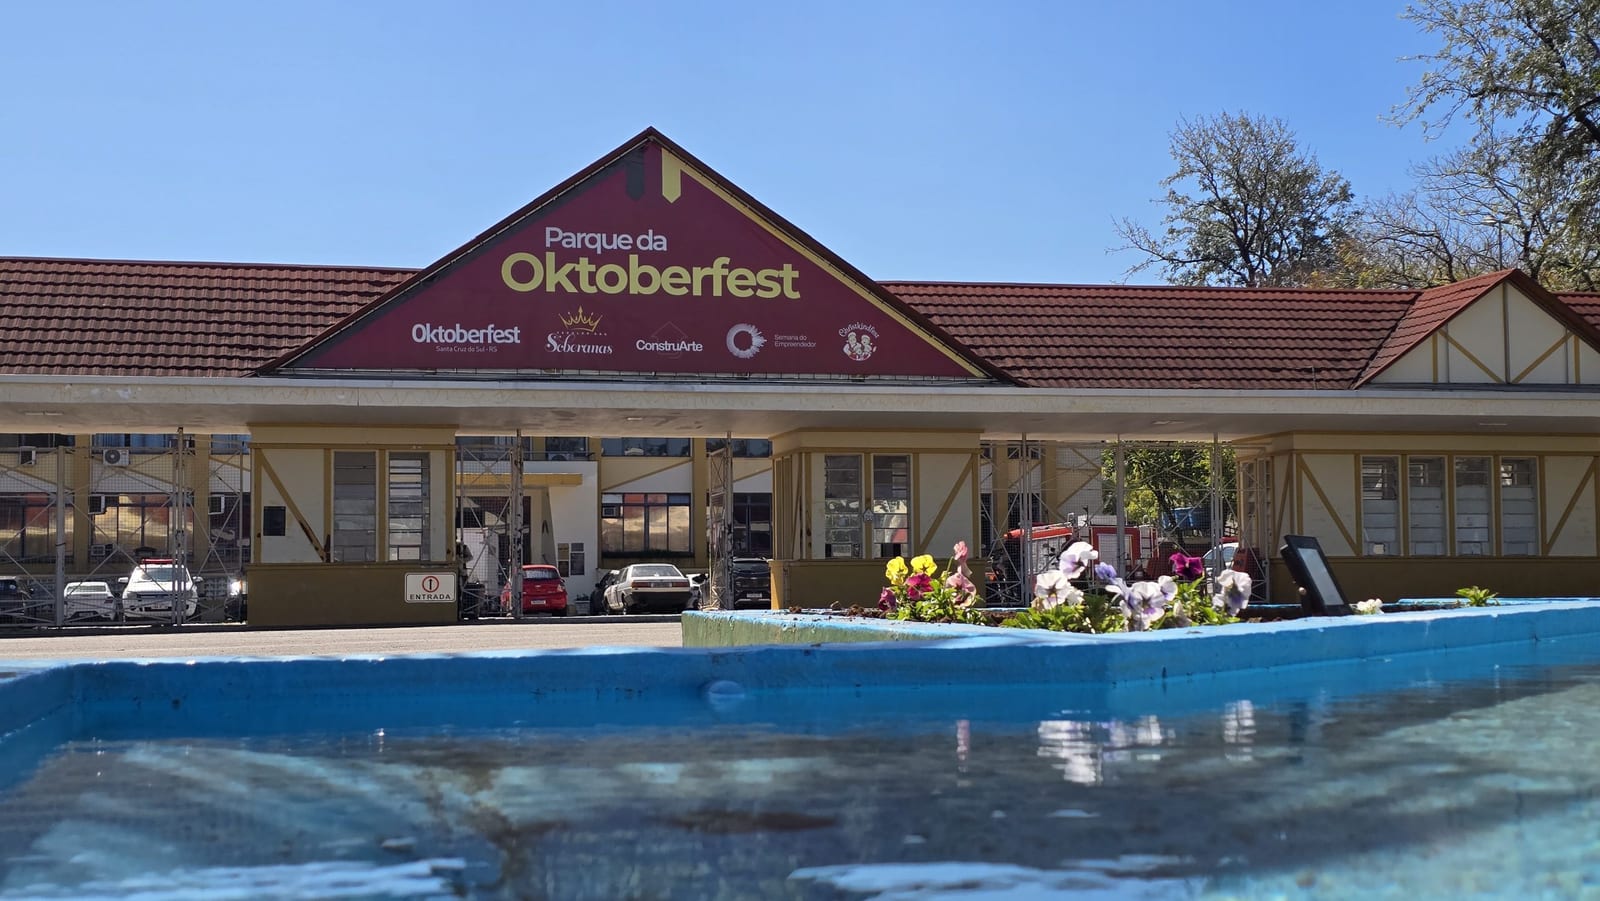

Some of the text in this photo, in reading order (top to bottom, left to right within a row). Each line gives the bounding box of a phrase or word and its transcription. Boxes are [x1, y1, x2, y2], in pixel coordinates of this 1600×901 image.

[545, 226, 668, 255] Parque da
[501, 251, 801, 299] Oktoberfest
[411, 322, 521, 344] Oktoberfest
[544, 332, 614, 355] Soberanas
[435, 345, 453, 353] Santa
[635, 339, 704, 352] ConstruArte
